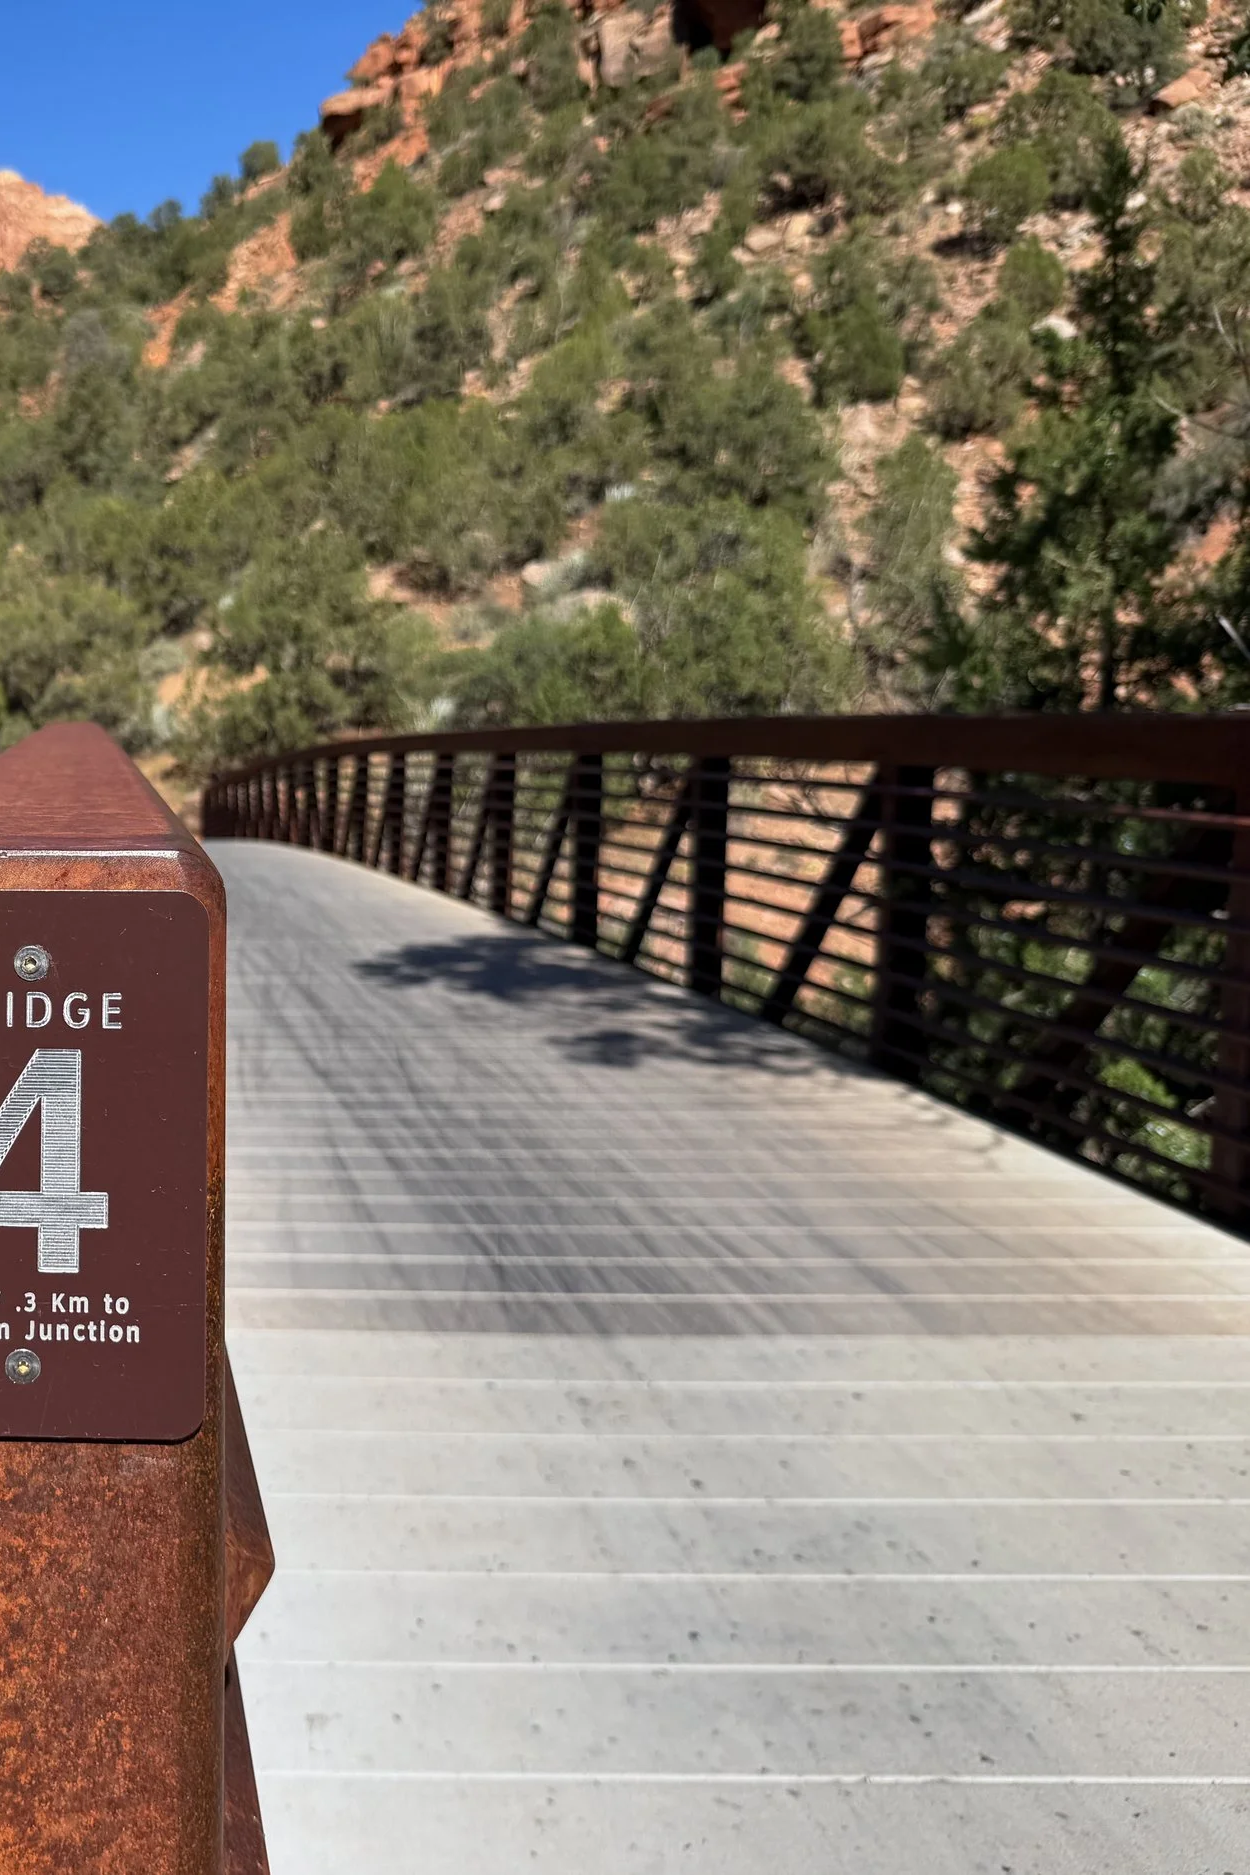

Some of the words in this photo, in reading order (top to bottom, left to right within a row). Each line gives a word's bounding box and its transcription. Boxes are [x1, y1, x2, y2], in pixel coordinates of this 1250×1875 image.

[15, 1291, 37, 1313] .3
[51, 1292, 90, 1314] Km
[103, 1293, 130, 1315] to
[24, 1319, 141, 1344] Junction
